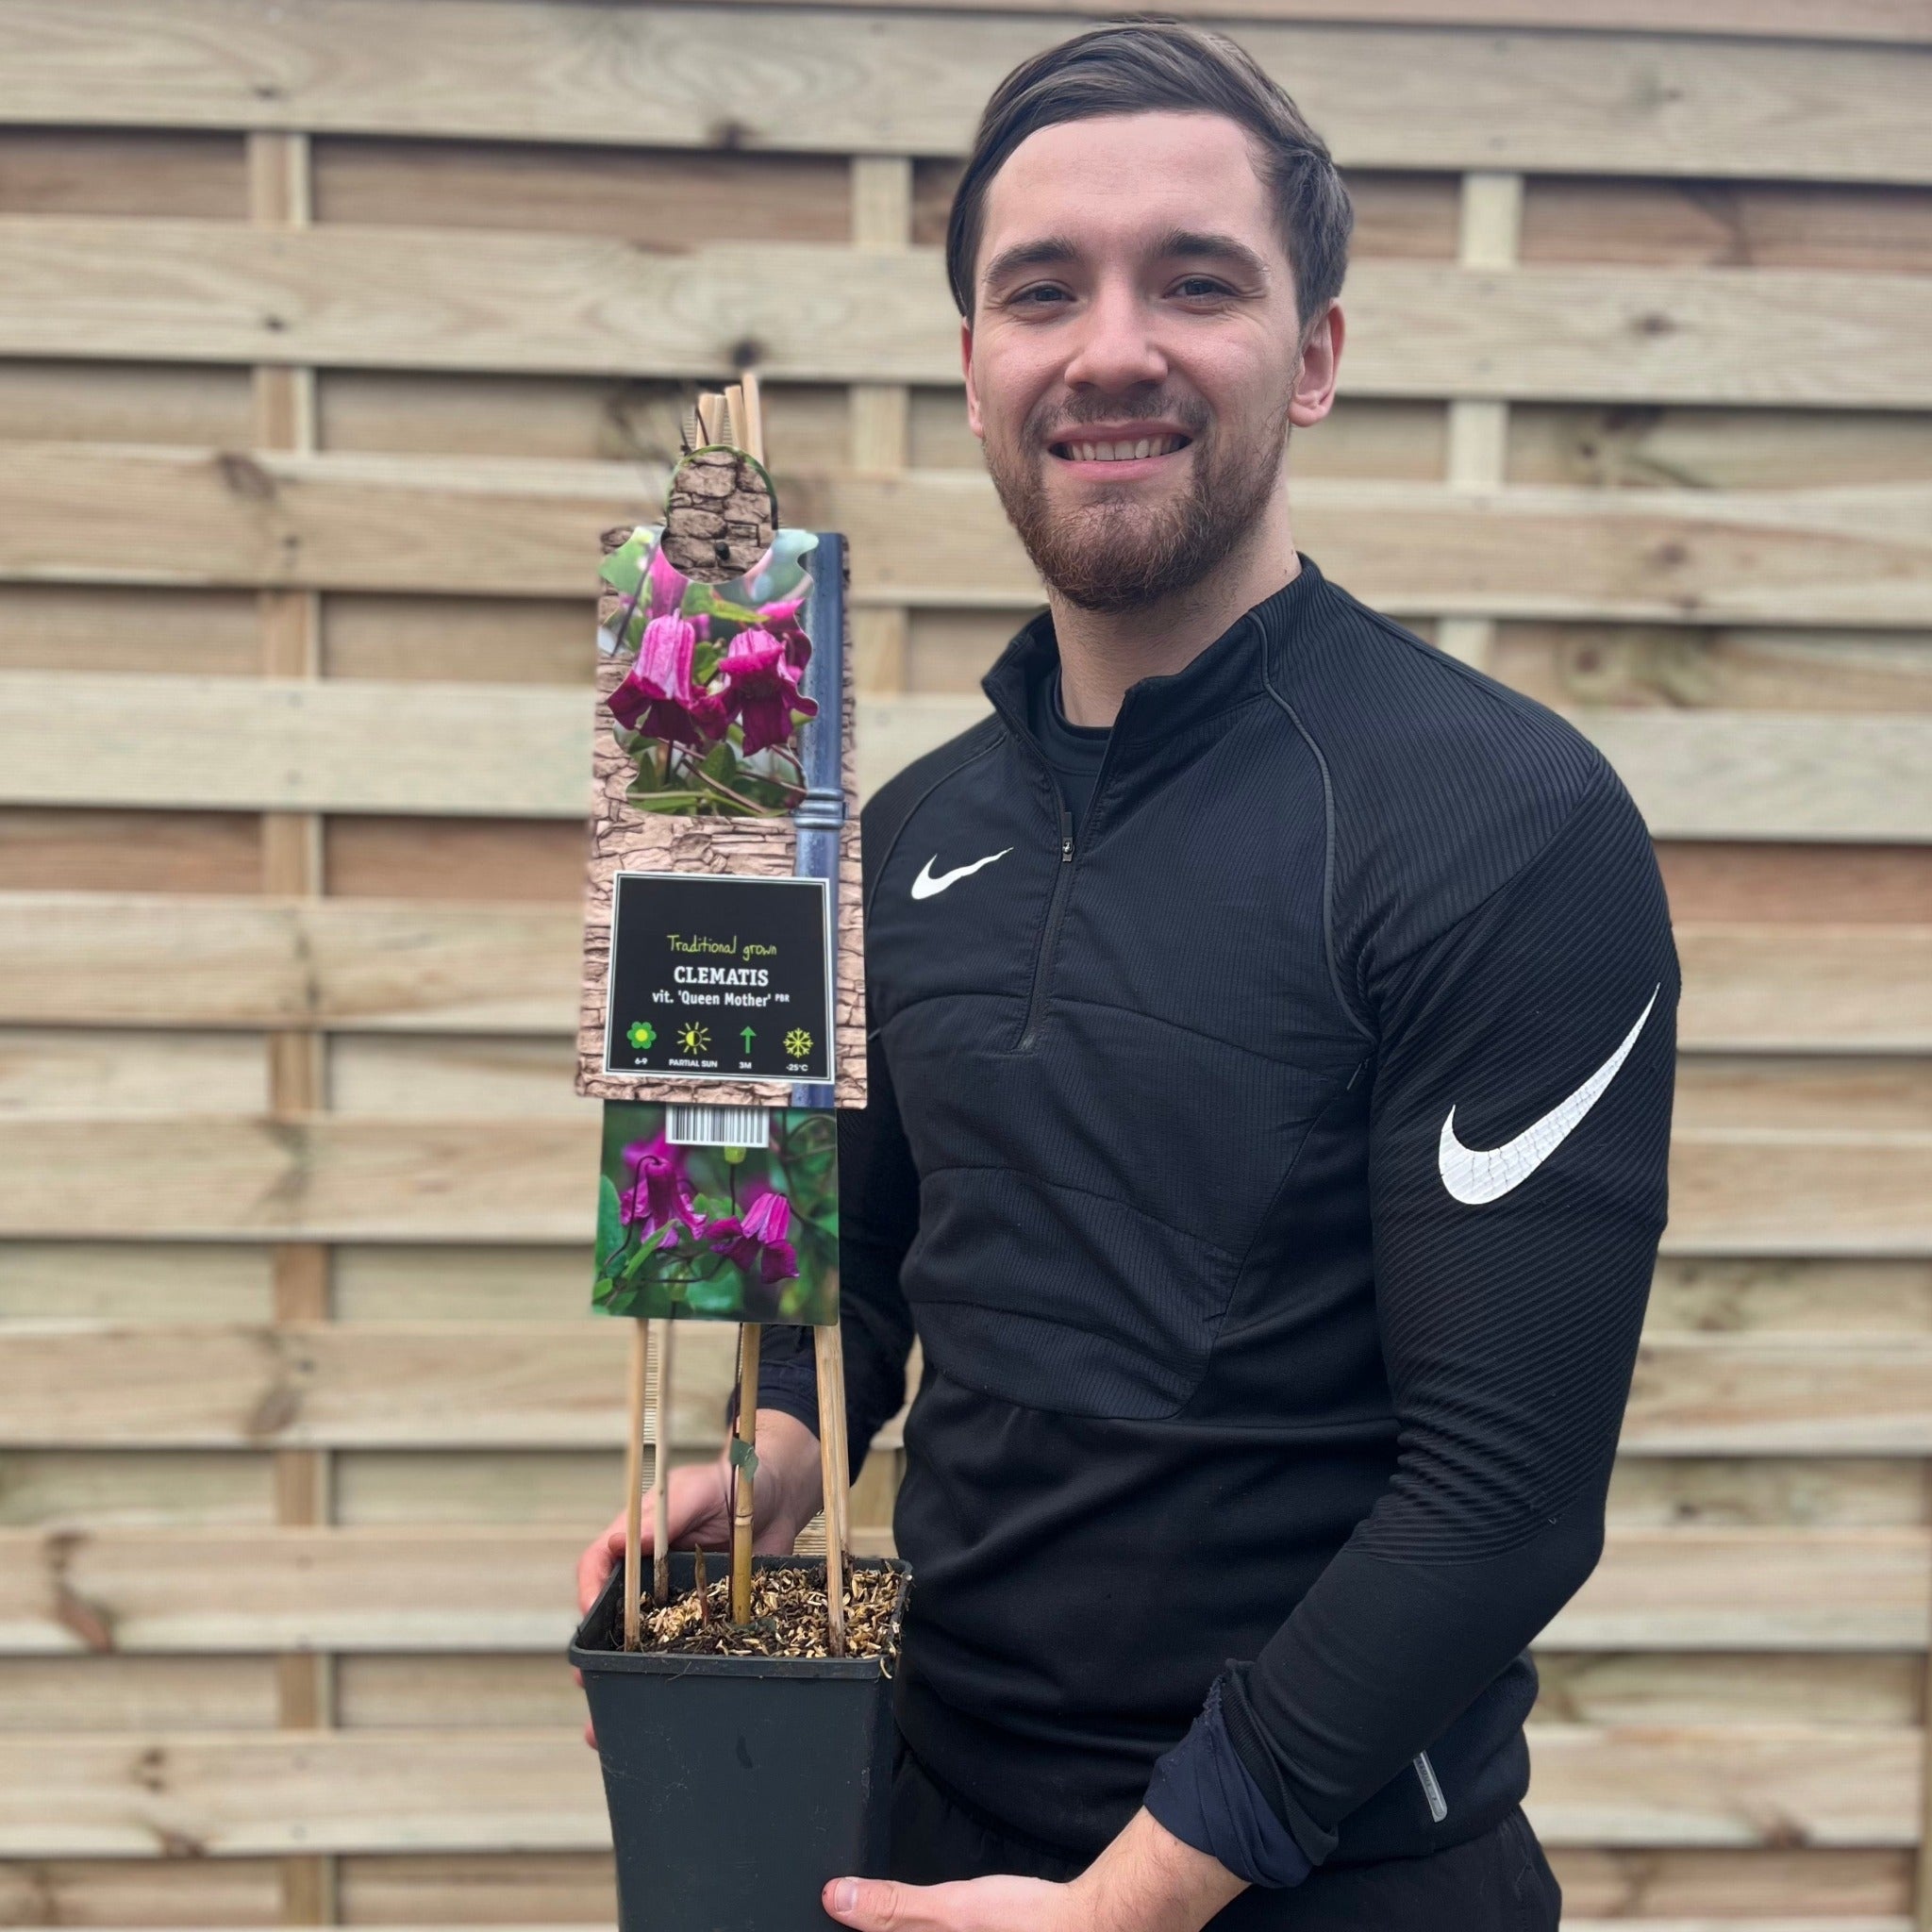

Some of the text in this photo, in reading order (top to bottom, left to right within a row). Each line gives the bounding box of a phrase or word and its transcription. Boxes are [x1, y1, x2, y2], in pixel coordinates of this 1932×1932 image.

[666, 934, 777, 961] Traditional grown
[674, 965, 769, 987] CLEMATIS
[652, 989, 790, 1008] vit. 'Queen Mother' PBR
[668, 1058, 718, 1068] PARTIAL SUN
[739, 1061, 753, 1070] 3M
